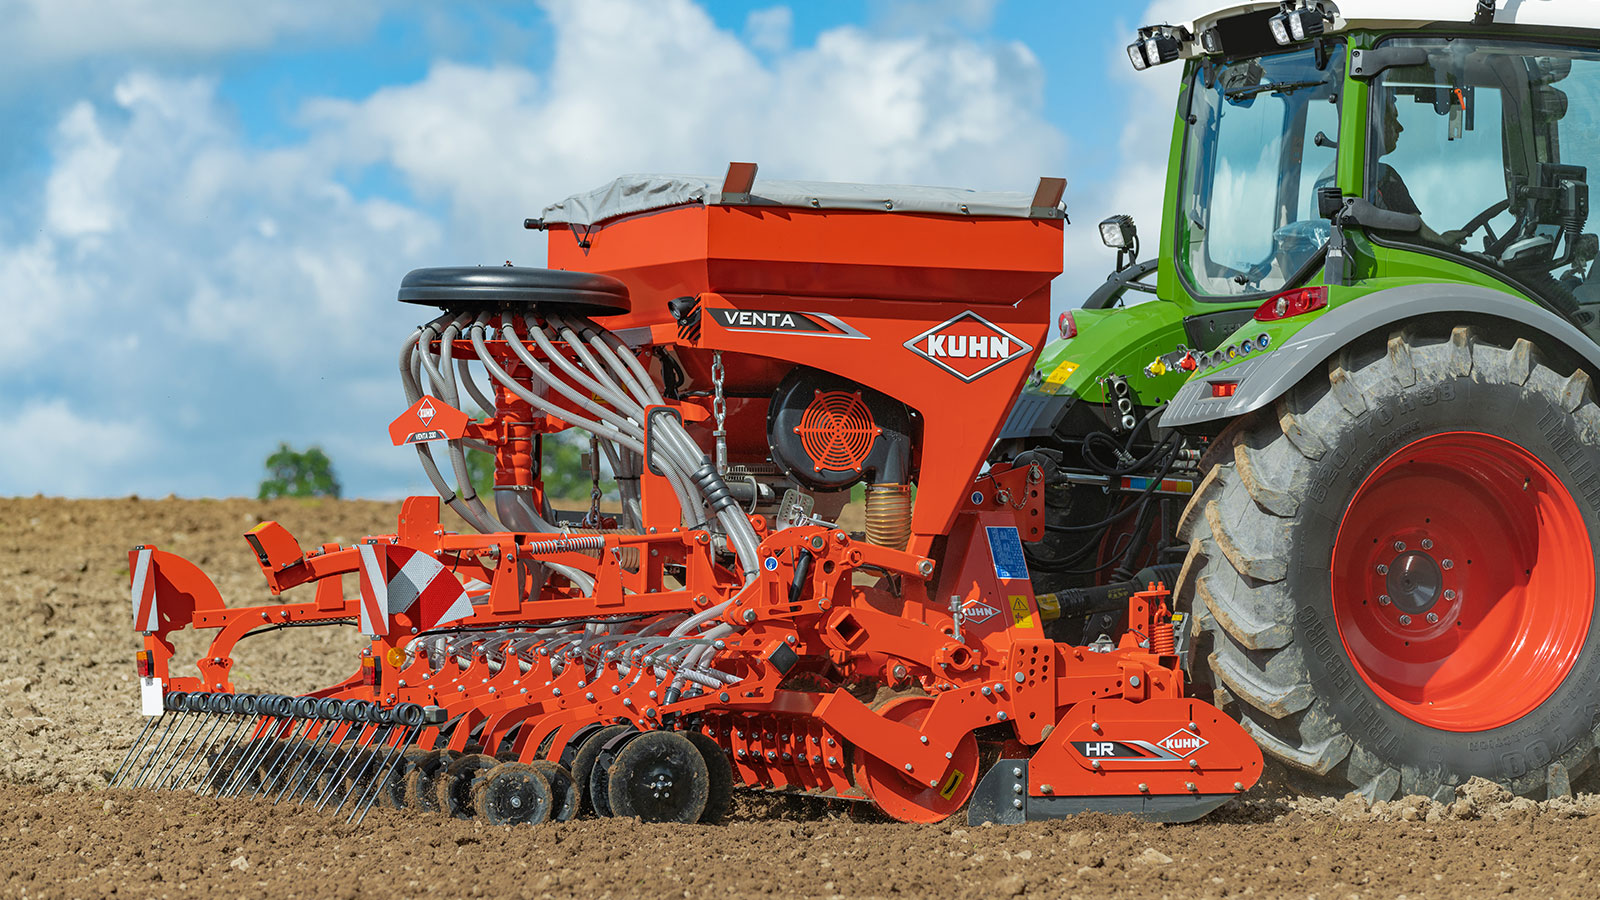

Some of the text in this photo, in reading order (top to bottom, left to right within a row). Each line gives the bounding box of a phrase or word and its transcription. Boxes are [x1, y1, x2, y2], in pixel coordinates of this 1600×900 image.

[724, 311, 796, 328] VENTA
[927, 334, 1011, 359] KUHN
[1296, 604, 1400, 762] TRELLEBORG
[1085, 742, 1116, 757] HR
[1165, 737, 1201, 749] KUHN
